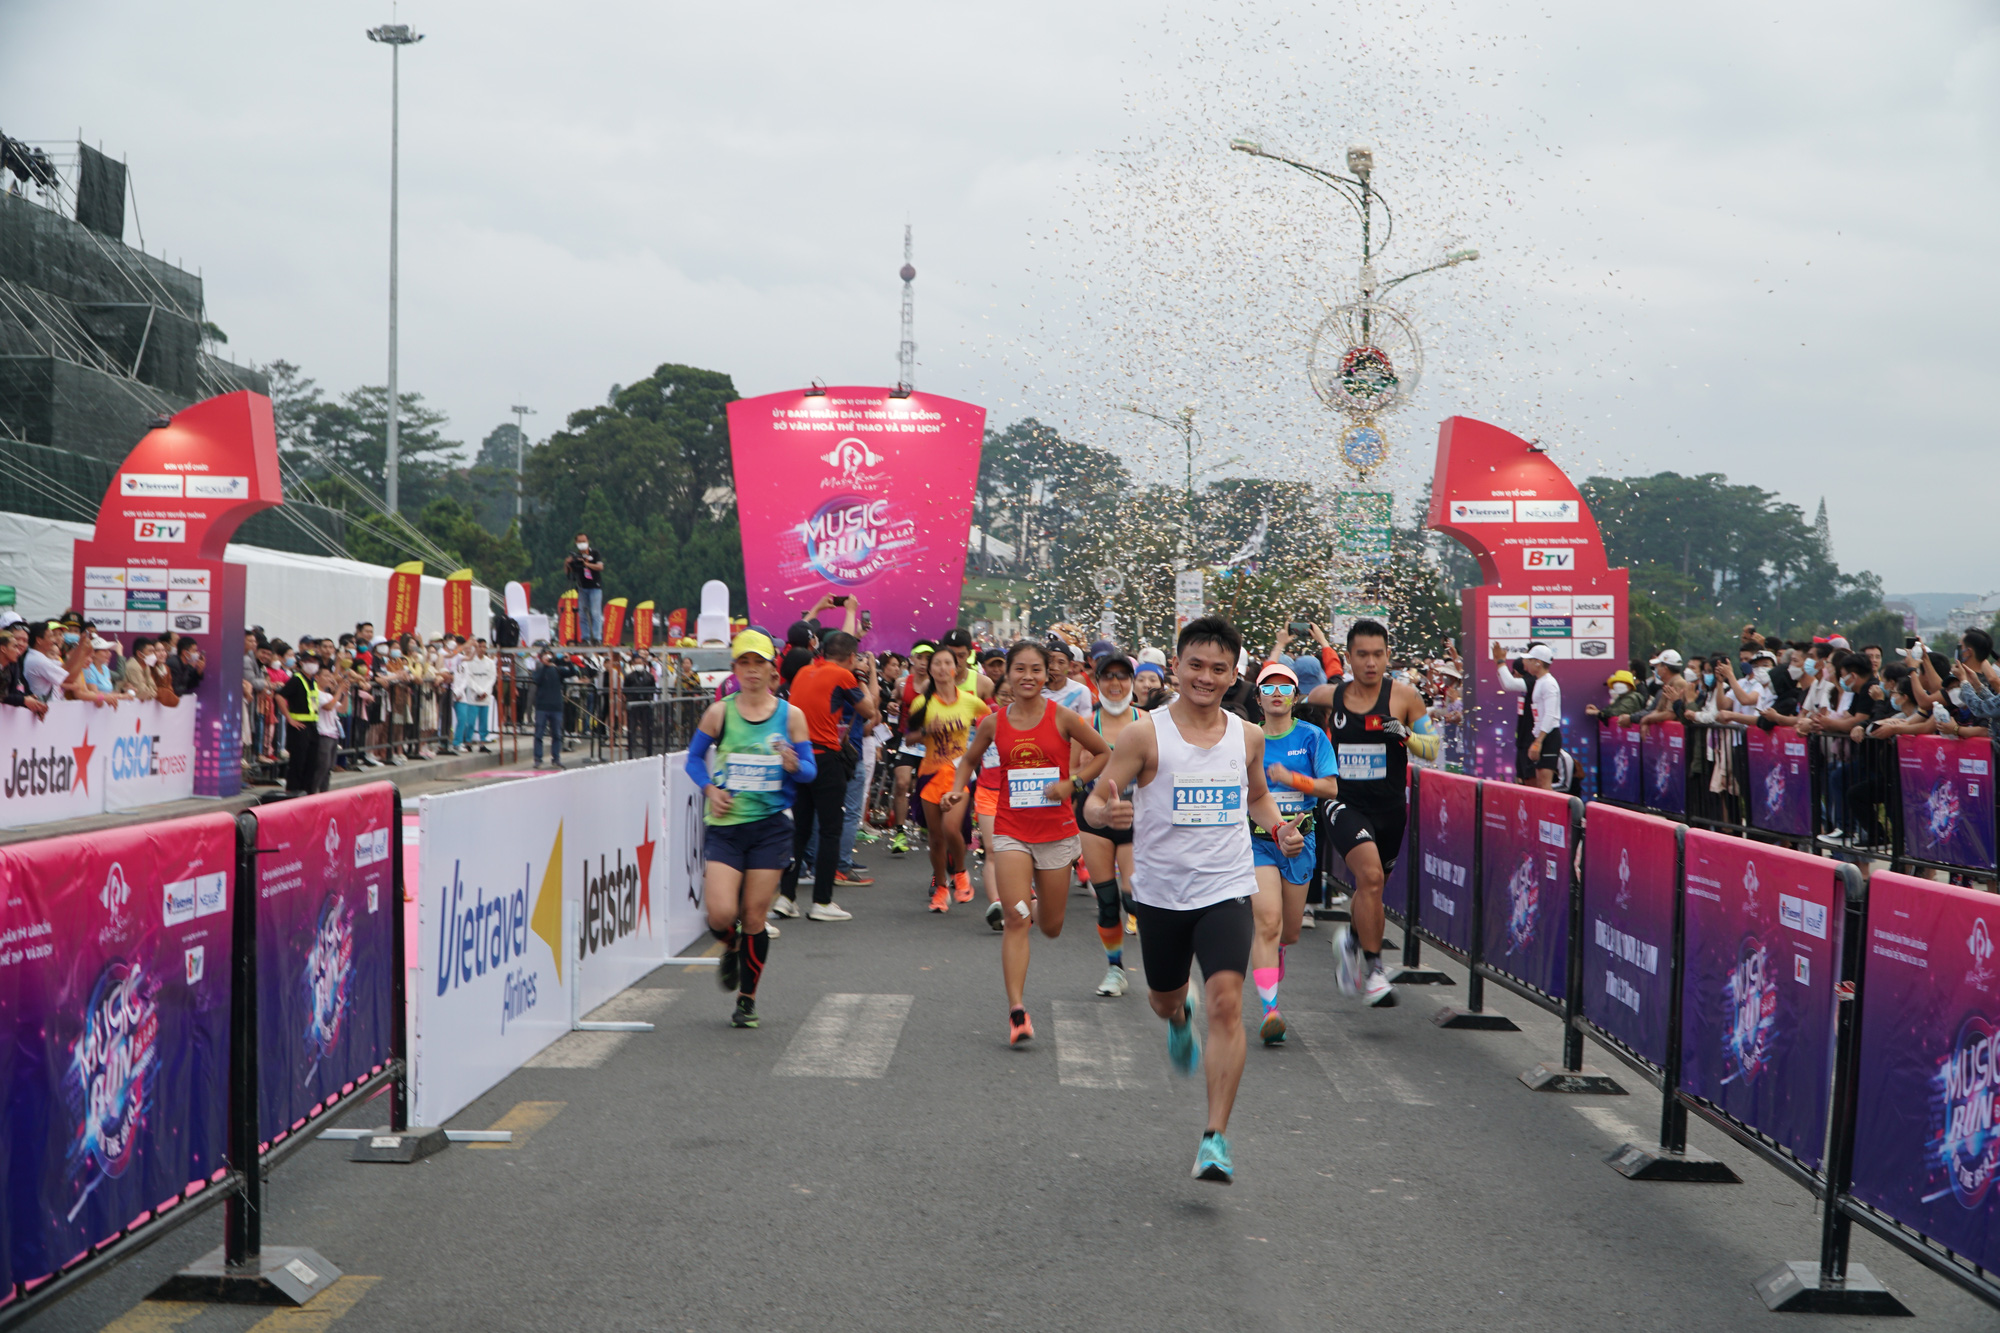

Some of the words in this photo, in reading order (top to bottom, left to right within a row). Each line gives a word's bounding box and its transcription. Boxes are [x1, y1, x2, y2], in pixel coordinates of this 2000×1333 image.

[787, 410, 808, 418] BAN
[810, 409, 839, 419] NHÂN
[840, 409, 862, 419] DÂN
[789, 420, 811, 431] VĂN
[856, 423, 884, 432] THAO
[884, 420, 900, 432] VÀ
[901, 424, 916, 432] DU
[1468, 508, 1510, 516] Vietravel
[802, 499, 888, 544] MUSIC
[139, 522, 180, 538] BTV
[818, 528, 877, 560] RUN
[838, 567, 858, 578] THE
[859, 554, 885, 576] BEAT
[1528, 551, 1569, 566] BTV
[1340, 755, 1370, 764] 21065
[4, 747, 74, 799] Jetstar
[1010, 780, 1044, 792] 21004
[1176, 789, 1224, 804] 21035
[1218, 812, 1228, 822] 21
[578, 848, 638, 961] Jetstar
[437, 859, 530, 997] Vietravel
[501, 967, 538, 1036] Airlines
[1950, 1091, 1994, 1143] RUN
